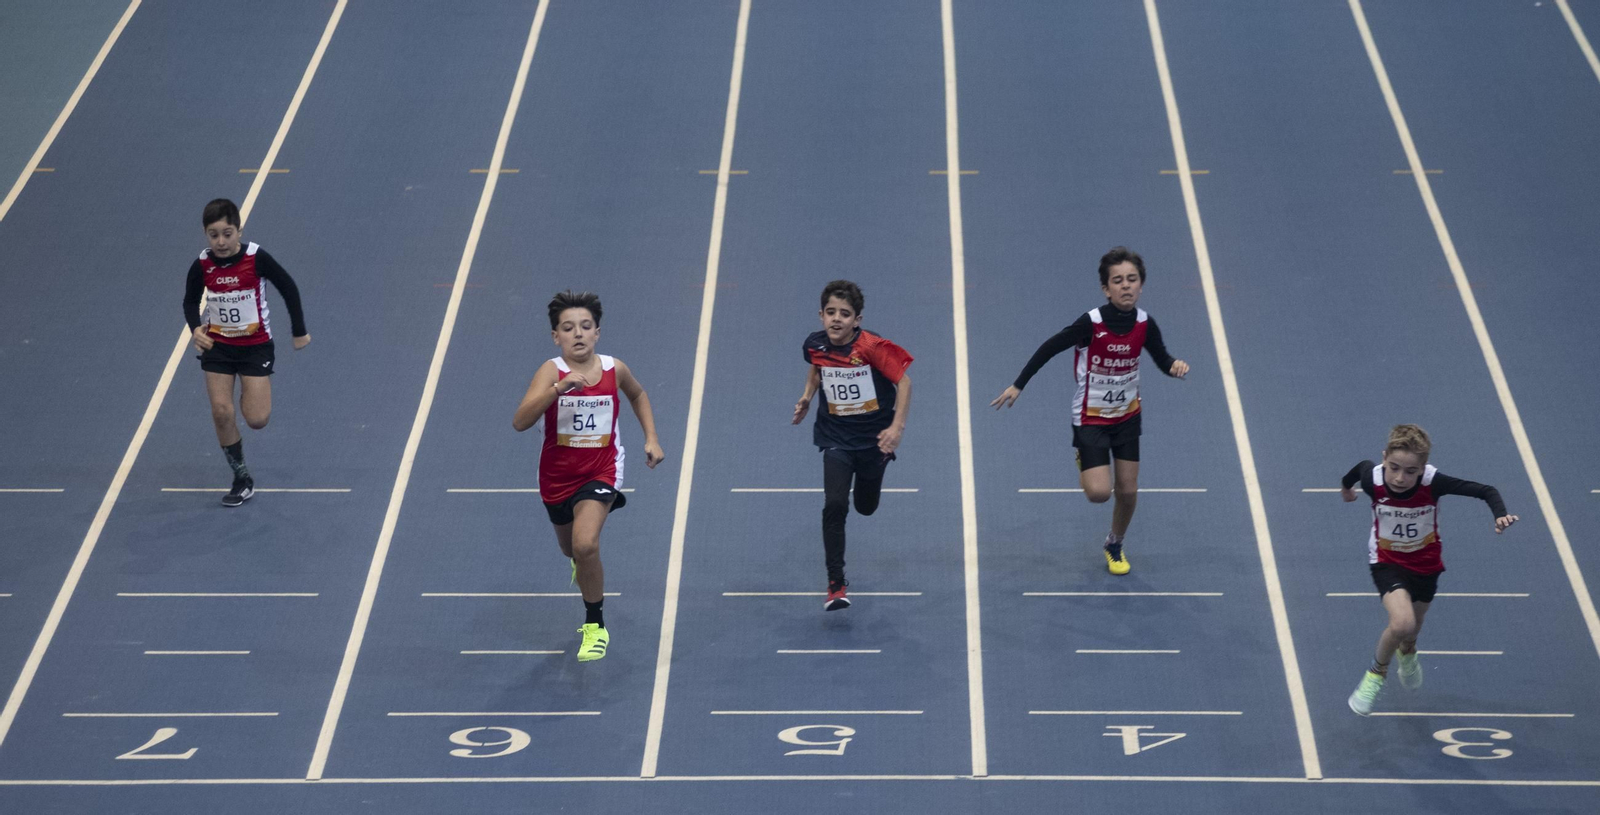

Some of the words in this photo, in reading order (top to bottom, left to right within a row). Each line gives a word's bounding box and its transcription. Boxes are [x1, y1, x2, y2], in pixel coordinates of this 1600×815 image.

[219, 308, 241, 323] 58
[1092, 355, 1101, 365] O
[822, 370, 834, 378] La
[830, 384, 861, 401] 189
[1102, 389, 1127, 404] 44
[560, 399, 575, 408] La
[572, 413, 597, 432] 54
[1391, 523, 1419, 539] 46
[115, 727, 200, 760] 7
[448, 726, 532, 759] 6
[778, 725, 856, 757] 5
[1103, 725, 1187, 757] 4
[1433, 727, 1513, 760] 3
